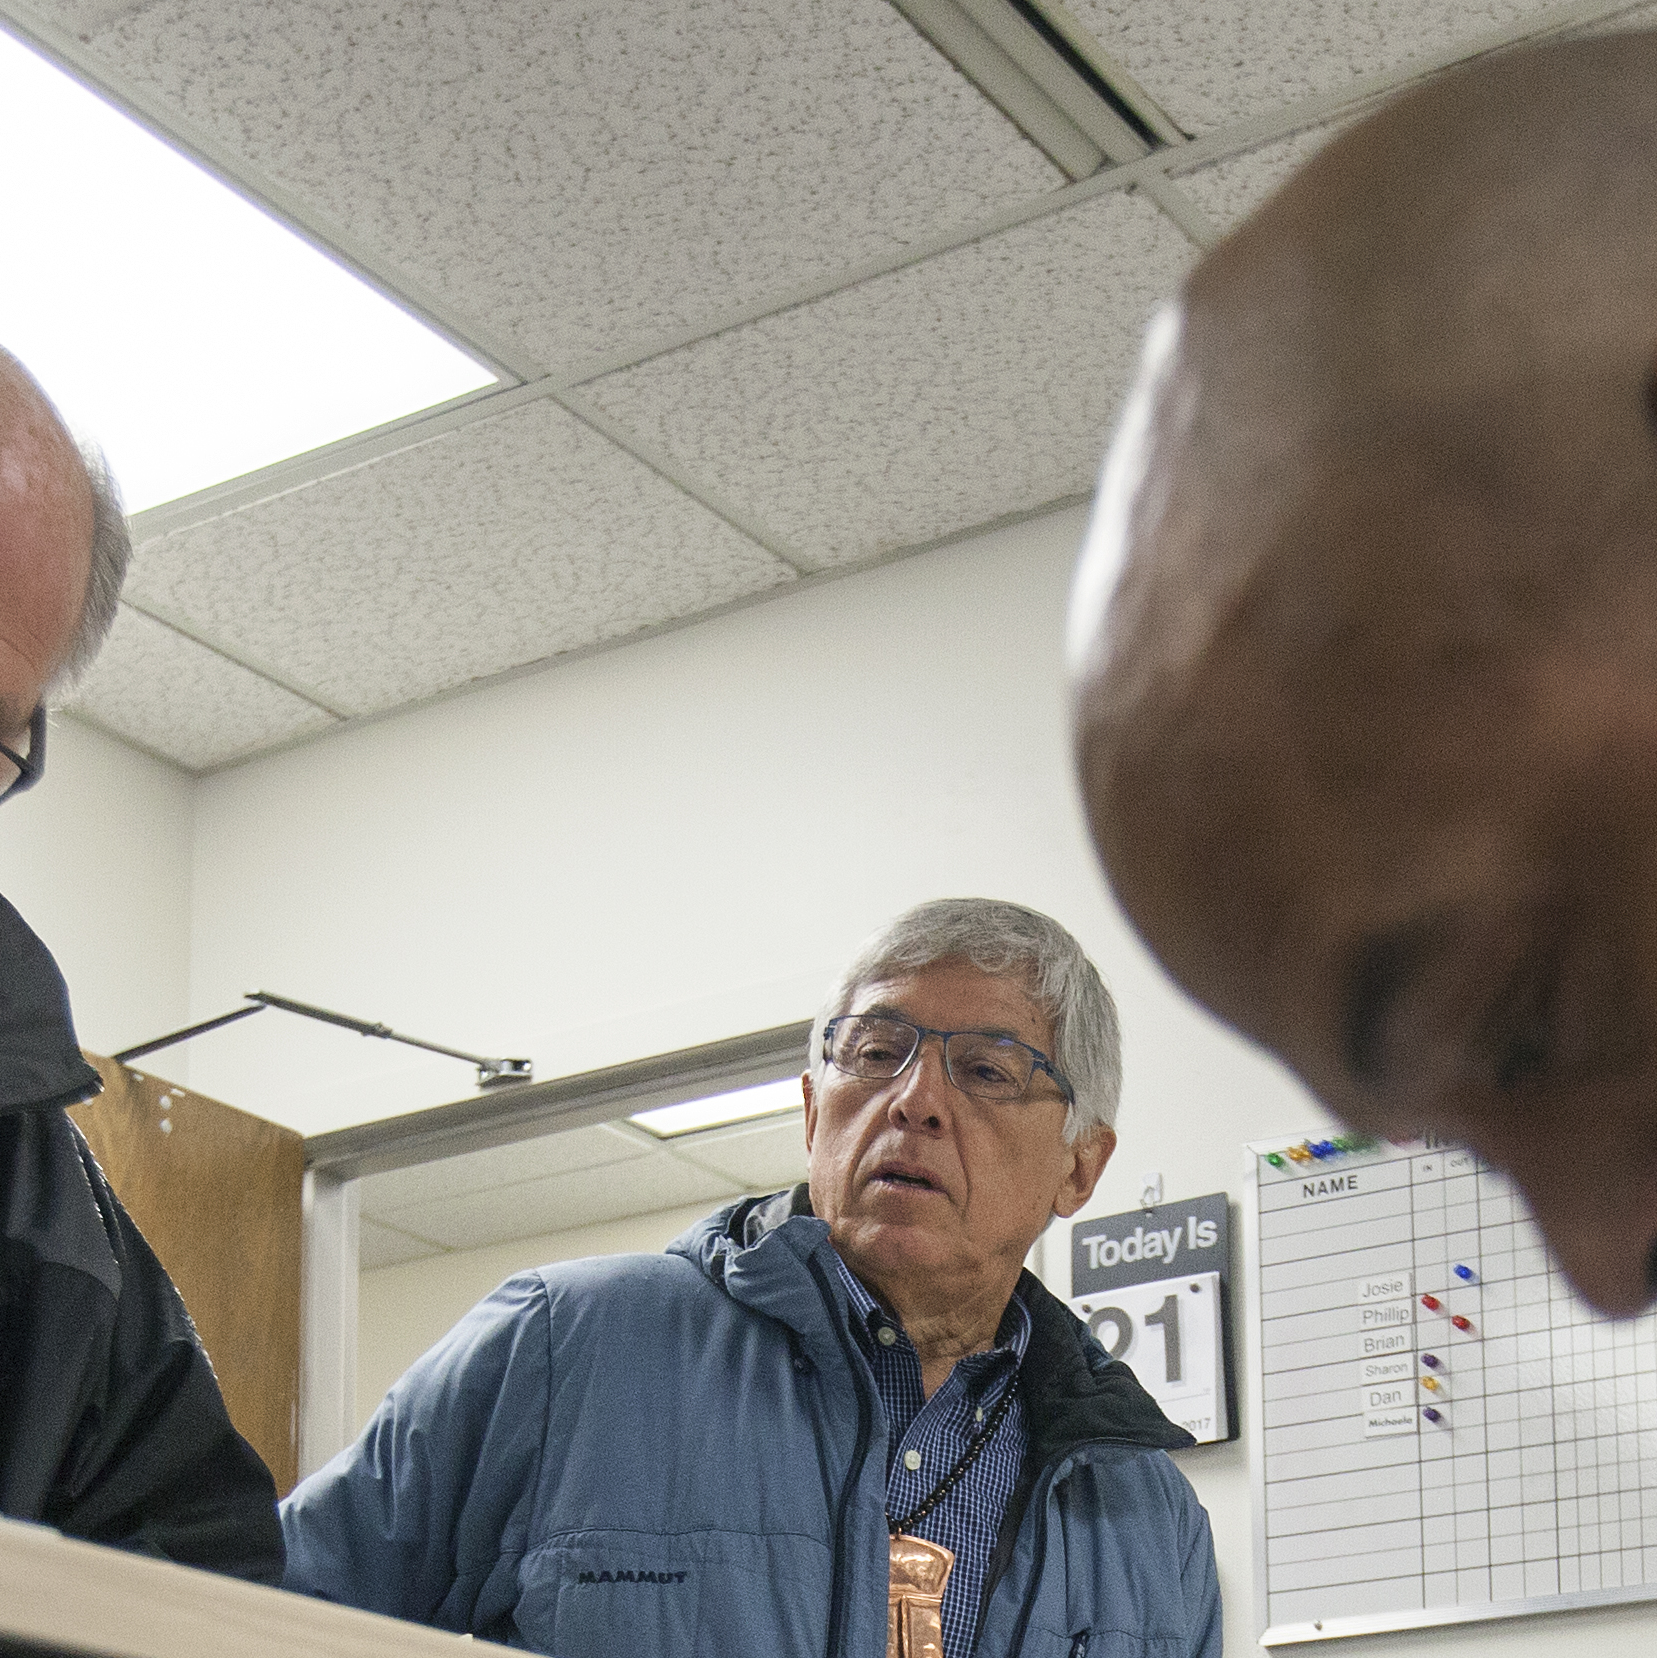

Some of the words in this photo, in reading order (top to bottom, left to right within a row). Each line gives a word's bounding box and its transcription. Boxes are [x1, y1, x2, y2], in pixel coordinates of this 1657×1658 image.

[1302, 1175, 1358, 1199] NAME
[1082, 1227, 1182, 1270] Today
[1188, 1216, 1218, 1250] Is
[1363, 1280, 1403, 1298] Josie
[1362, 1307, 1410, 1325] Phillip
[1364, 1334, 1405, 1353] Brian
[1365, 1362, 1409, 1377] Sharon
[1370, 1390, 1402, 1407] Dan
[579, 1570, 687, 1584] MAMMUT
